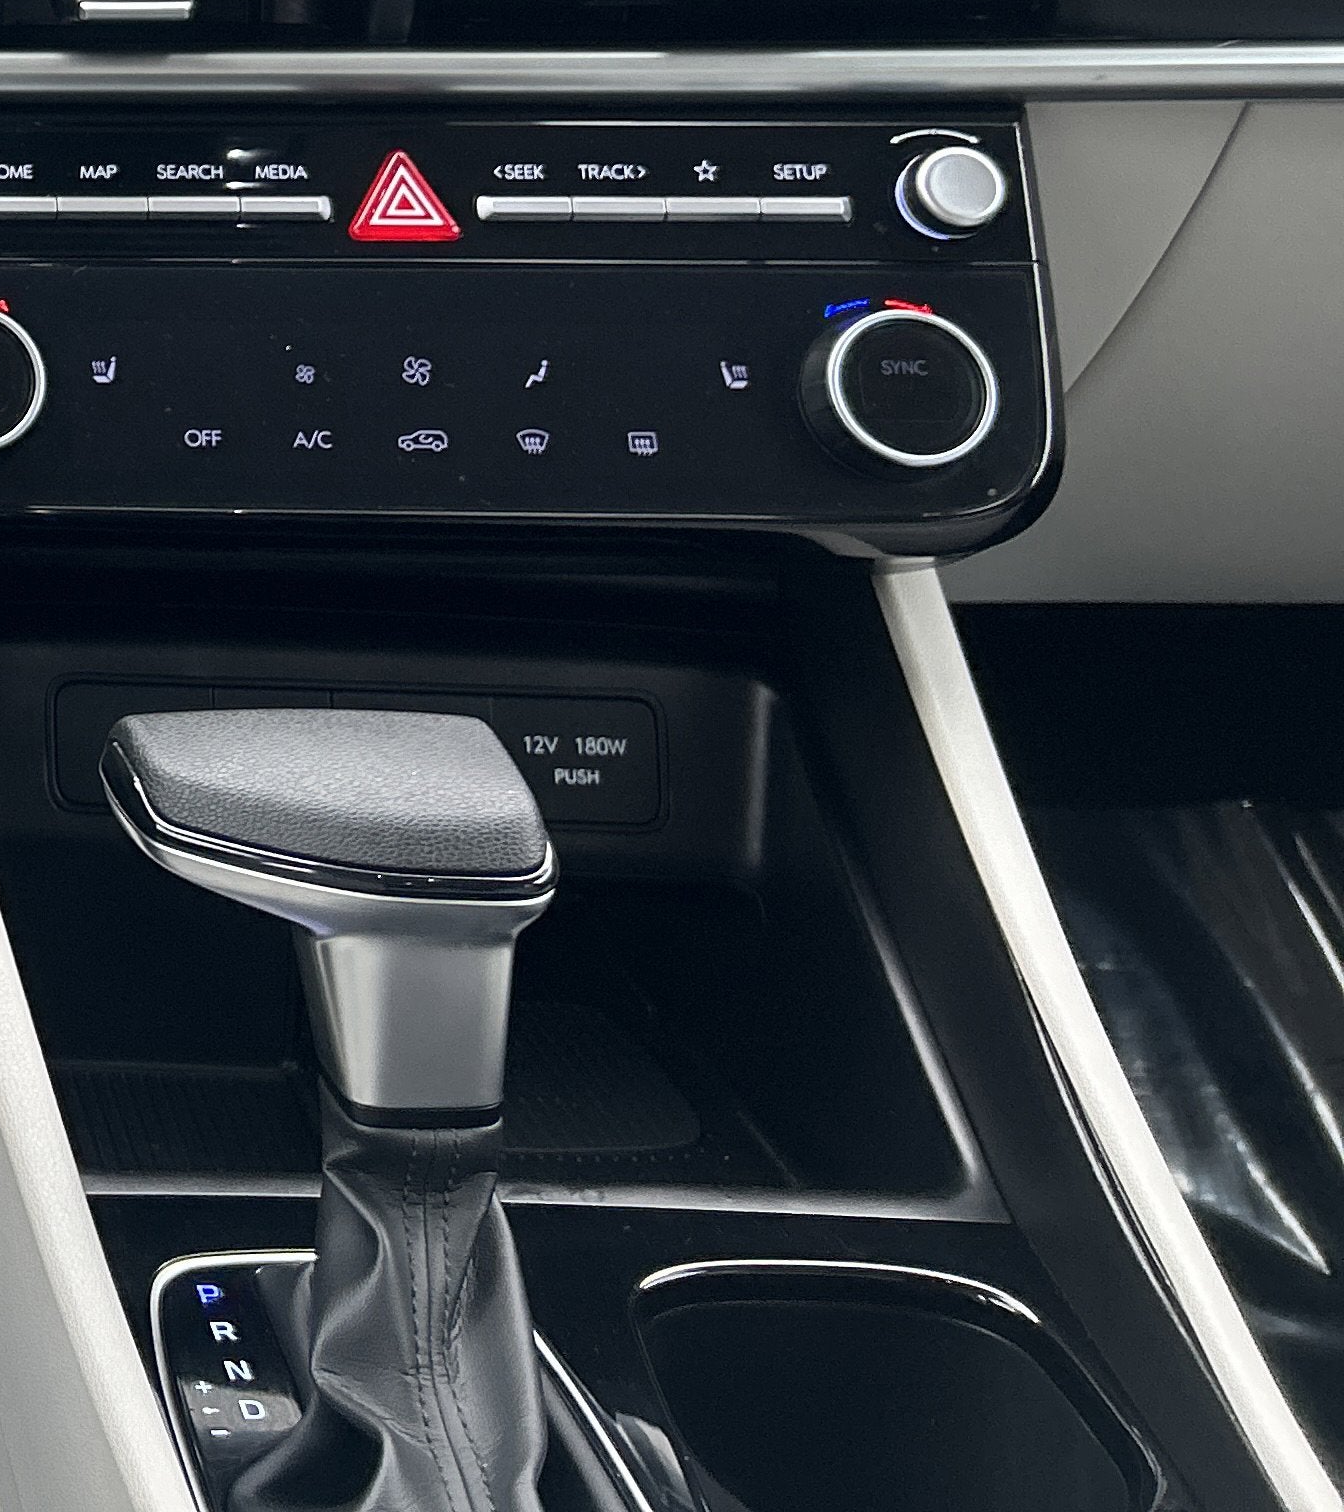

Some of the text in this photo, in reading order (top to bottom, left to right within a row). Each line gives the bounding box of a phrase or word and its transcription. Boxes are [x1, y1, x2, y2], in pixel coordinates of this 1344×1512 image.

[79, 164, 118, 181] MAP
[156, 164, 224, 181] SEARCH
[254, 164, 308, 181] MEDIA
[772, 164, 827, 181] SETUP
[879, 359, 929, 377] SYNC
[183, 430, 223, 448] OFF
[291, 431, 333, 449] A/C
[522, 735, 630, 757] 12V 180W
[553, 767, 601, 786] PUSH
[196, 1284, 224, 1304] P
[209, 1321, 238, 1341] R
[223, 1360, 254, 1380] N
[238, 1400, 266, 1420] D
